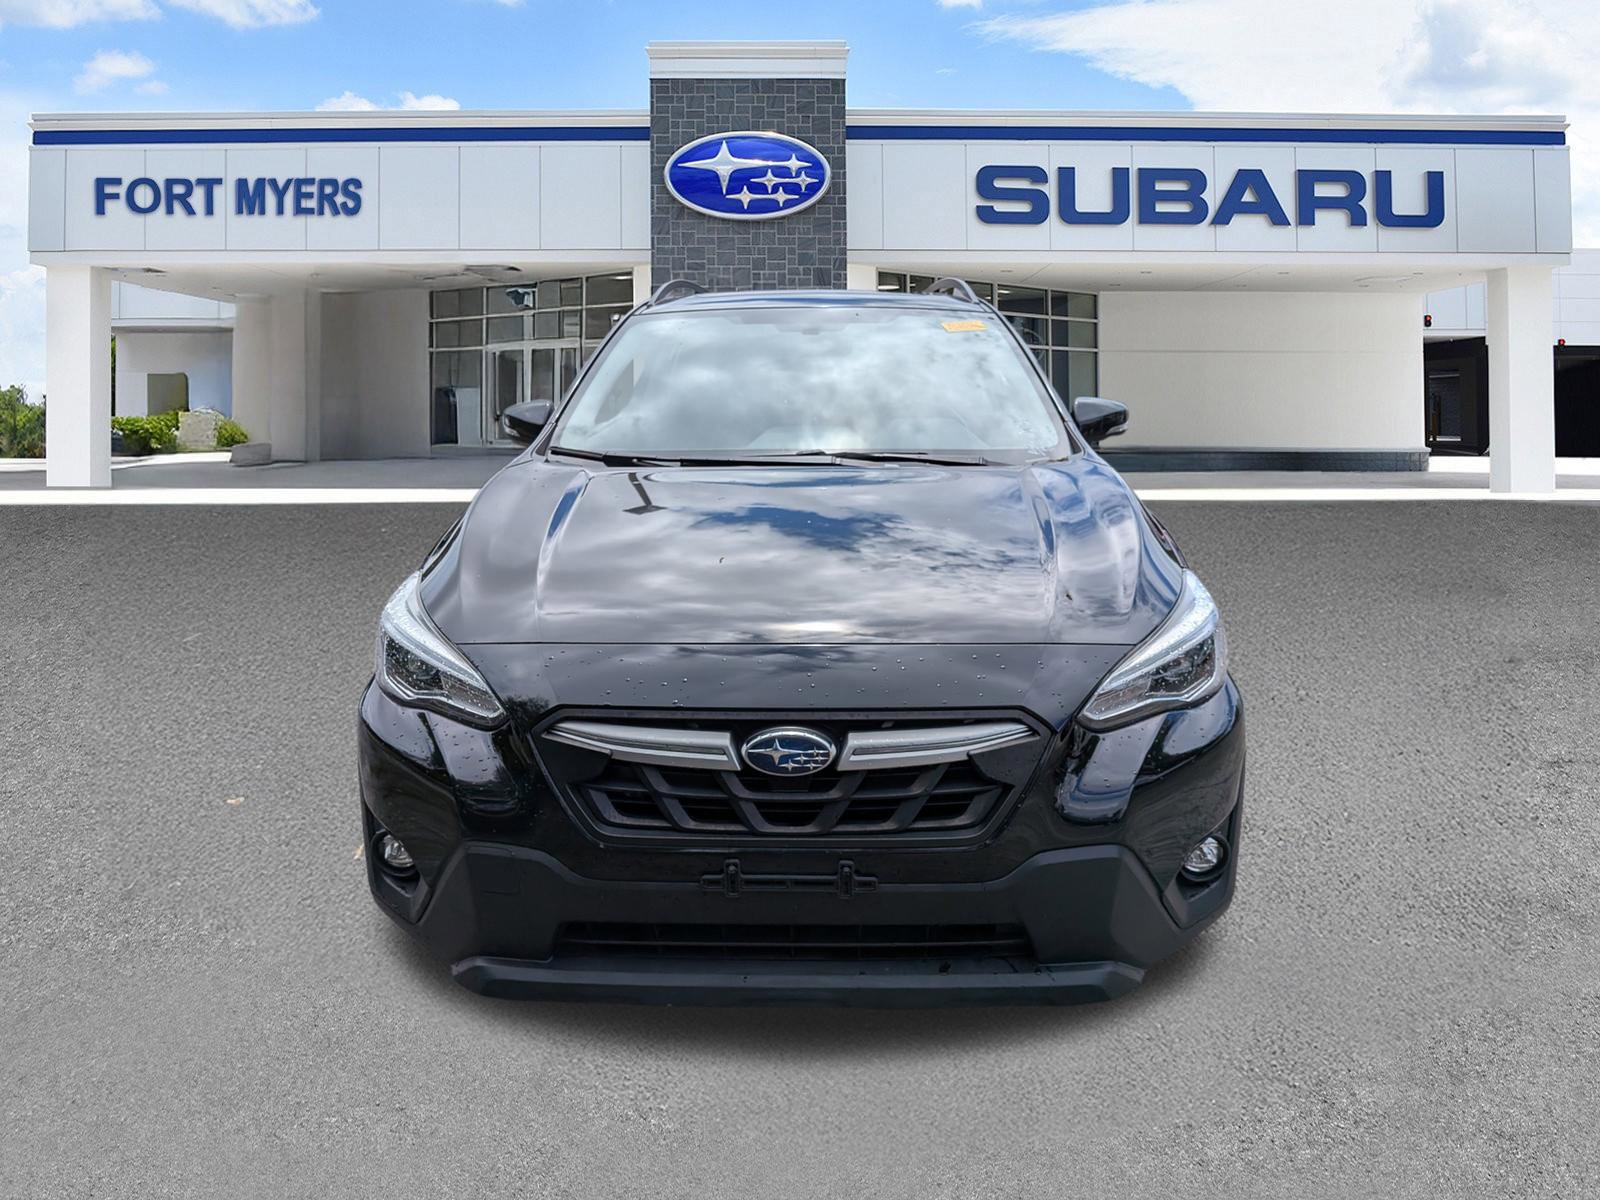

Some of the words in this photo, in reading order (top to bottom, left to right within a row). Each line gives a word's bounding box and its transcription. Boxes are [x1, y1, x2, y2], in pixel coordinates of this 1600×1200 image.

[95, 177, 223, 216] FORT
[235, 178, 363, 217] MYERS
[975, 165, 1445, 229] SUBARU
